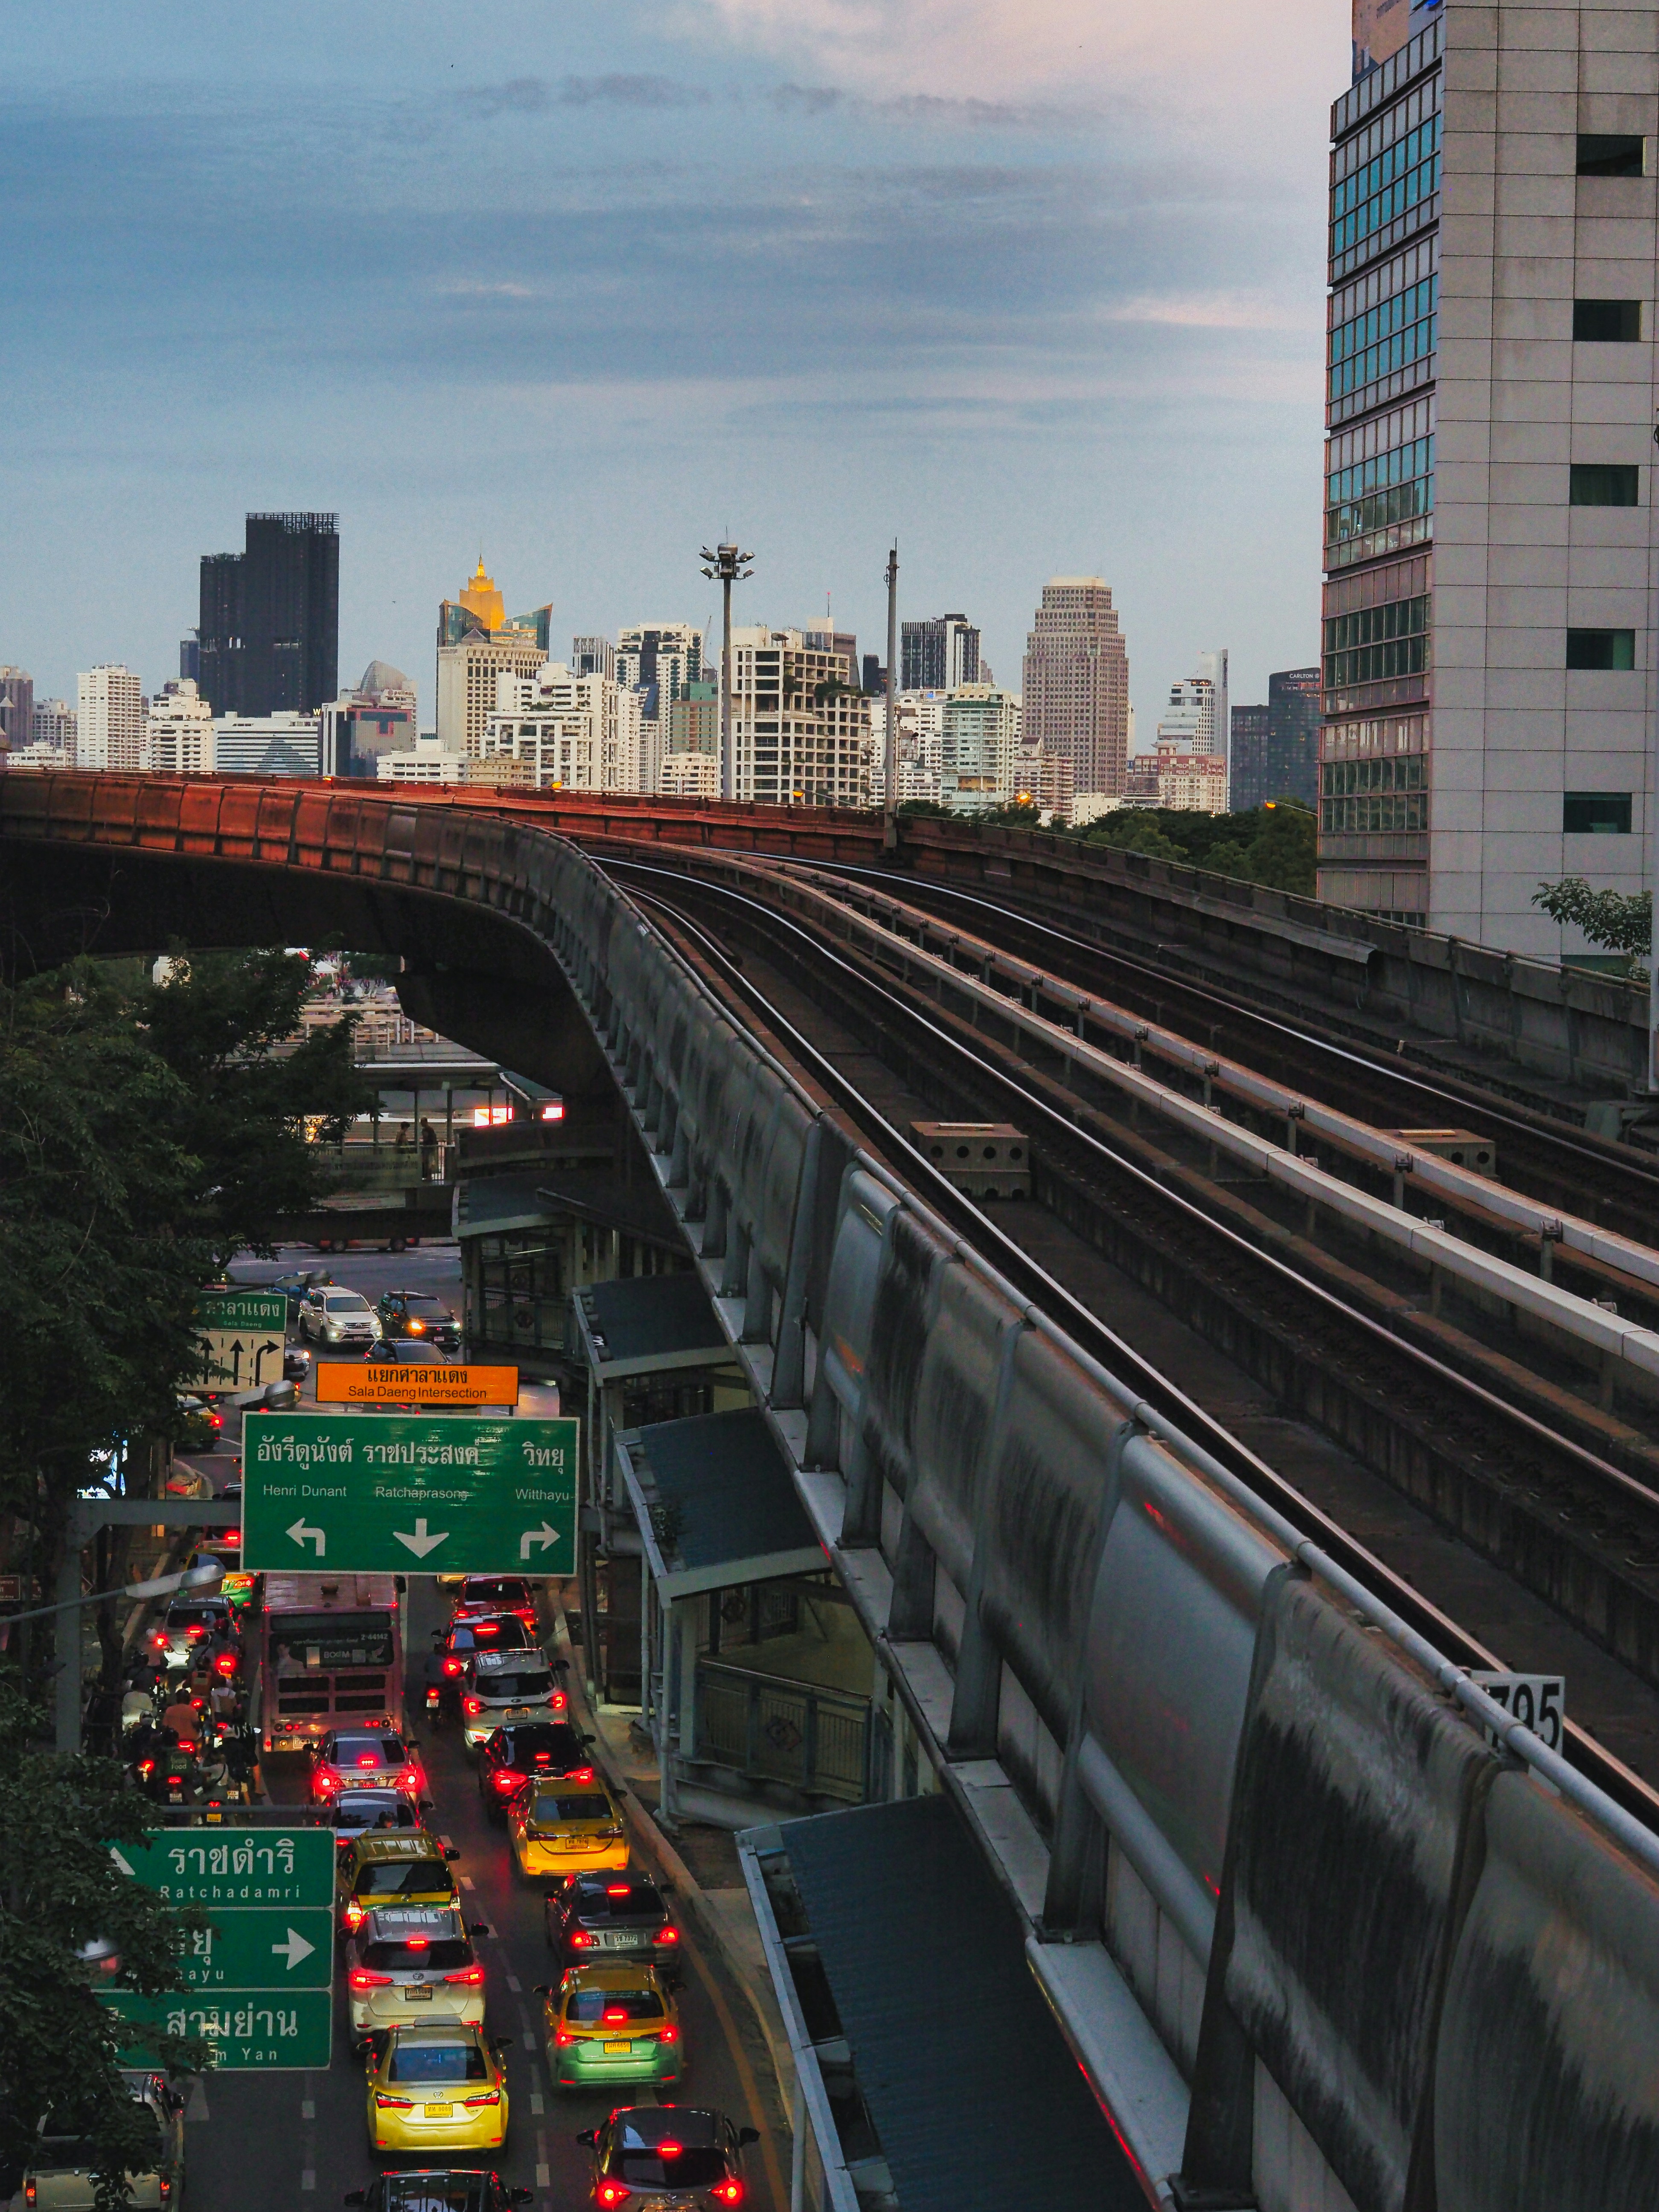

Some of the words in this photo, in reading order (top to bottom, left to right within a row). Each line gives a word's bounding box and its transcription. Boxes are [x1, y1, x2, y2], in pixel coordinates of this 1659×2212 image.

[367, 1367, 468, 1384] แยกศาลาแดง
[348, 1386, 375, 1397] Sala
[378, 1387, 416, 1400] Daeng
[418, 1388, 487, 1398] Intersection
[257, 1435, 354, 1470] อังรีดูนังต์
[362, 1439, 480, 1466] ราชประสงค์
[522, 1441, 565, 1475] วิทยุ
[263, 1484, 297, 1497] Henri
[302, 1485, 347, 1497] Dunant
[375, 1486, 469, 1501] Ratchaprasong
[515, 1488, 570, 1501] Witthayu
[1489, 1683, 1560, 1750] 795
[168, 1838, 295, 1875] ราชดำริ
[160, 1885, 300, 1898] Ratchadamri
[167, 2002, 298, 2037] สามย่าน
[242, 2047, 278, 2061] Yan
